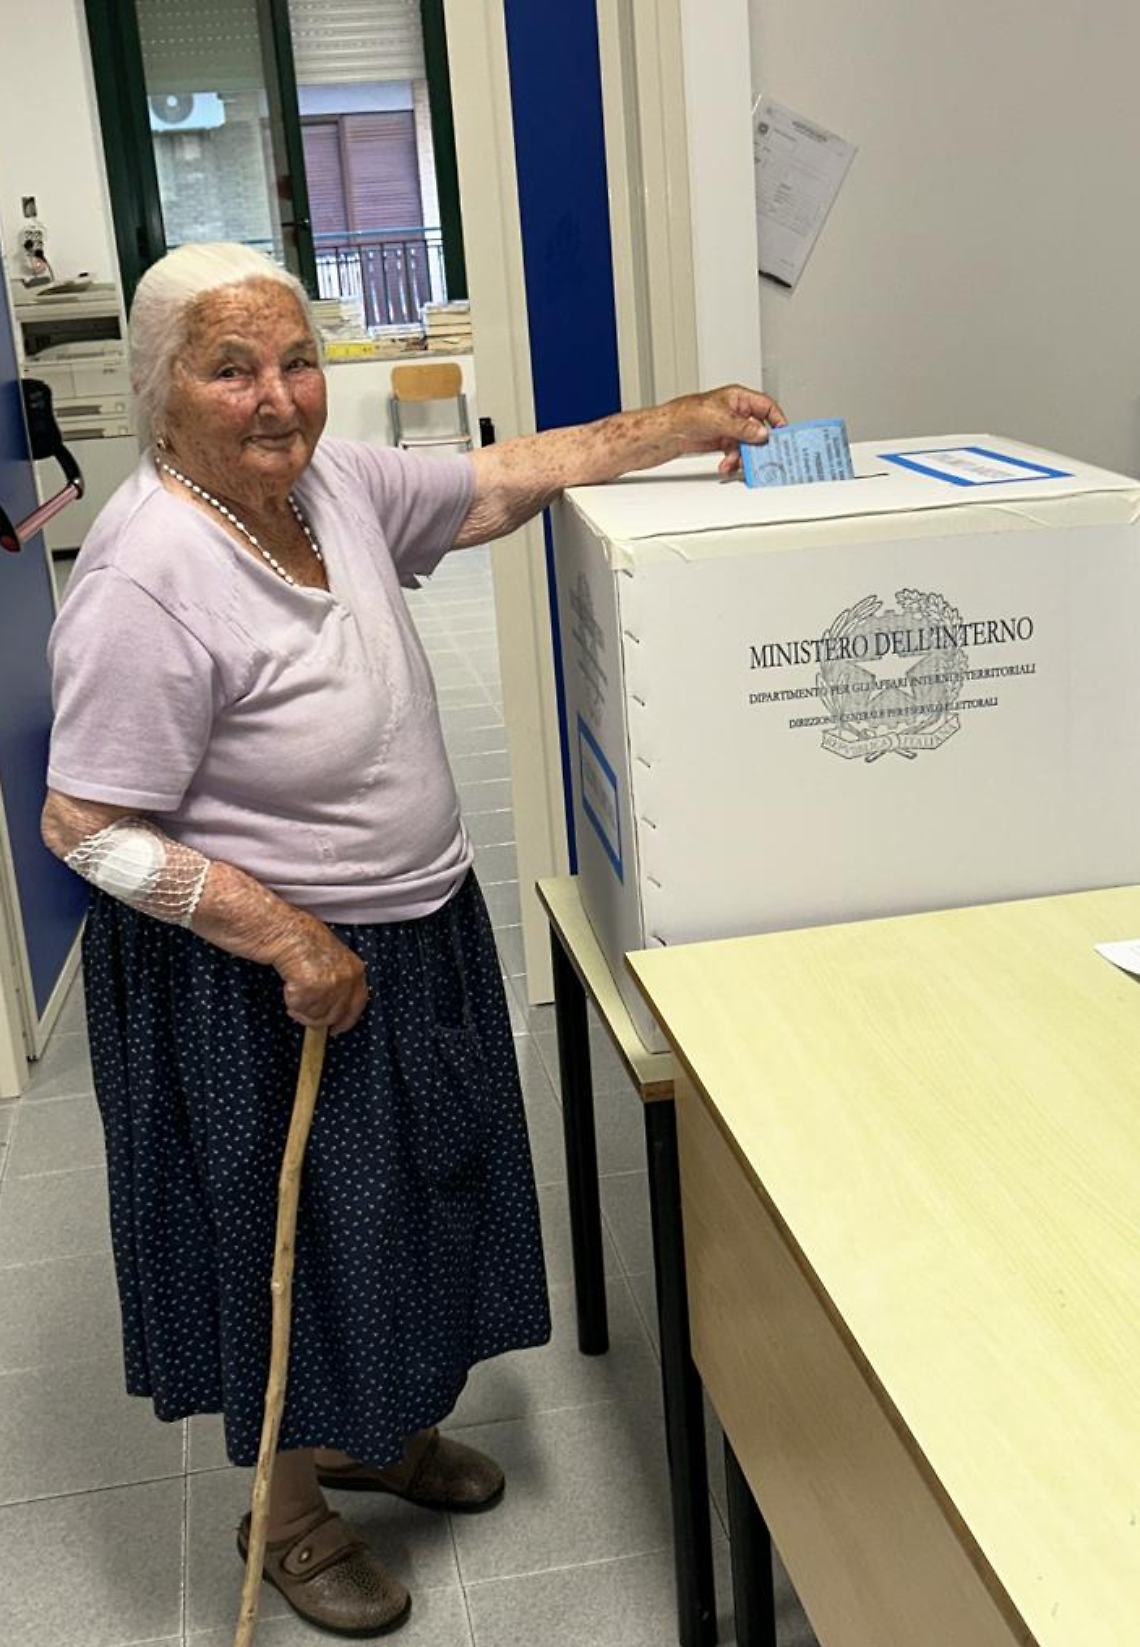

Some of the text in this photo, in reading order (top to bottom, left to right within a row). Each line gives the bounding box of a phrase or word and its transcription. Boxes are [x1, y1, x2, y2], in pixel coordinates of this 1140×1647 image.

[750, 616, 1034, 669] MINISTERO DELL'INTERNO
[749, 686, 828, 704] DIPARTIMENTO
[830, 683, 850, 696] PER
[852, 681, 870, 693] GLI
[963, 663, 1037, 681] TERRITORIALI
